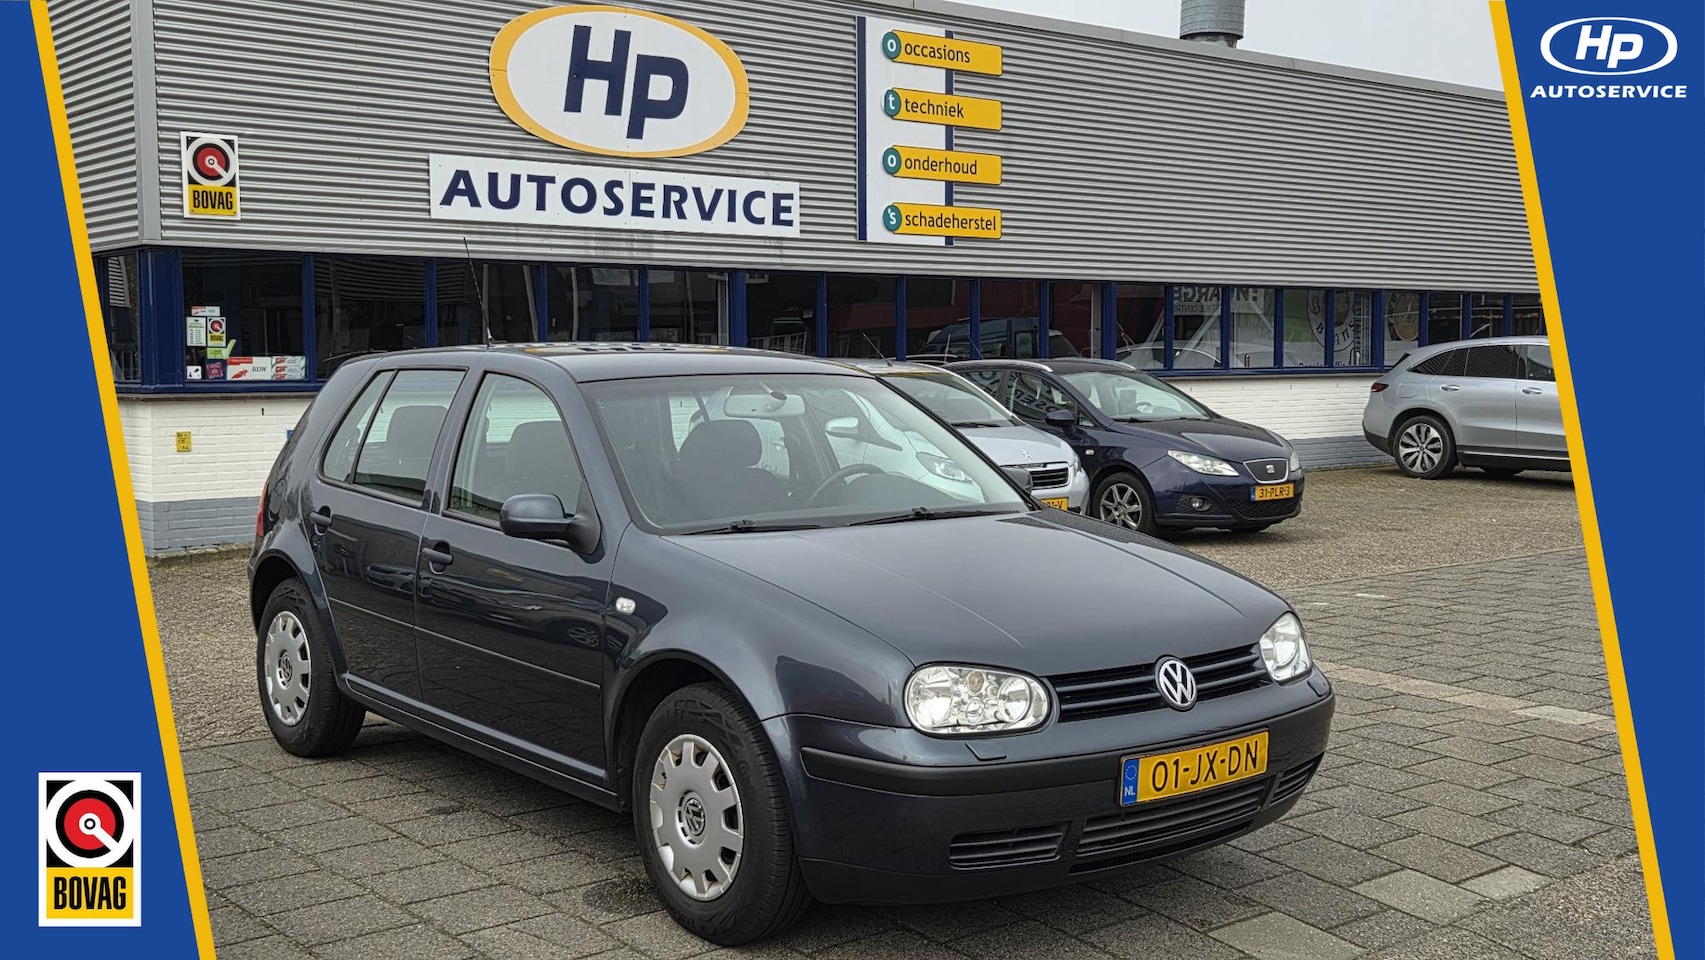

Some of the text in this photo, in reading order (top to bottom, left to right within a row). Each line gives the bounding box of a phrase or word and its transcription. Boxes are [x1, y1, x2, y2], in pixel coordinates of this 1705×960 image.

[904, 43, 970, 63] occasions
[905, 98, 964, 118] techniek
[904, 156, 978, 175] onderhoud
[193, 190, 233, 210] BOVAG
[440, 169, 794, 227] AUTOSERVICE
[905, 212, 996, 231] schadeherstel
[1259, 486, 1290, 498] 31-PLR-3
[1152, 740, 1258, 792] 01-JX-DN
[1124, 786, 1136, 797] NL
